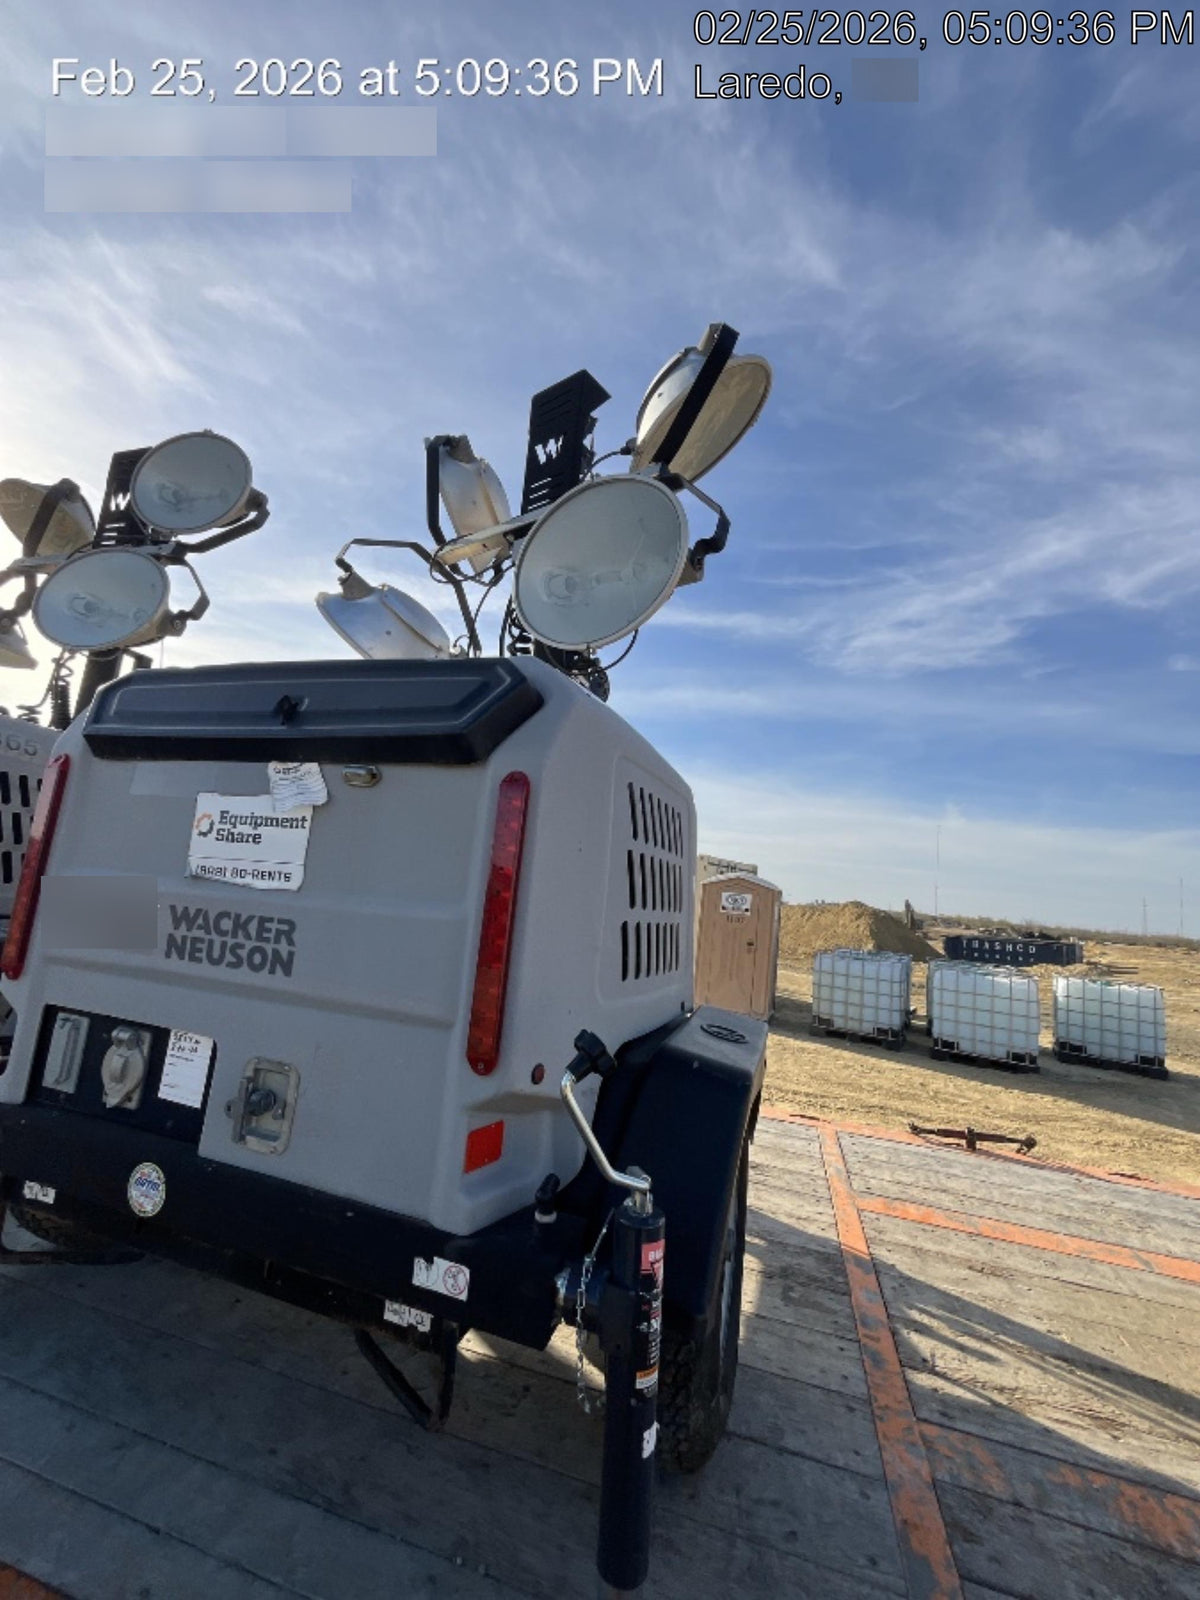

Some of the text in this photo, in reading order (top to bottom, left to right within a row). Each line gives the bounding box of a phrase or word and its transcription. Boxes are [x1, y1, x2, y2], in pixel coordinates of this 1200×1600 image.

[218, 810, 308, 830] Equipment
[215, 828, 262, 845] Share
[169, 904, 297, 947] WACKER
[164, 933, 296, 978] NEUSON
